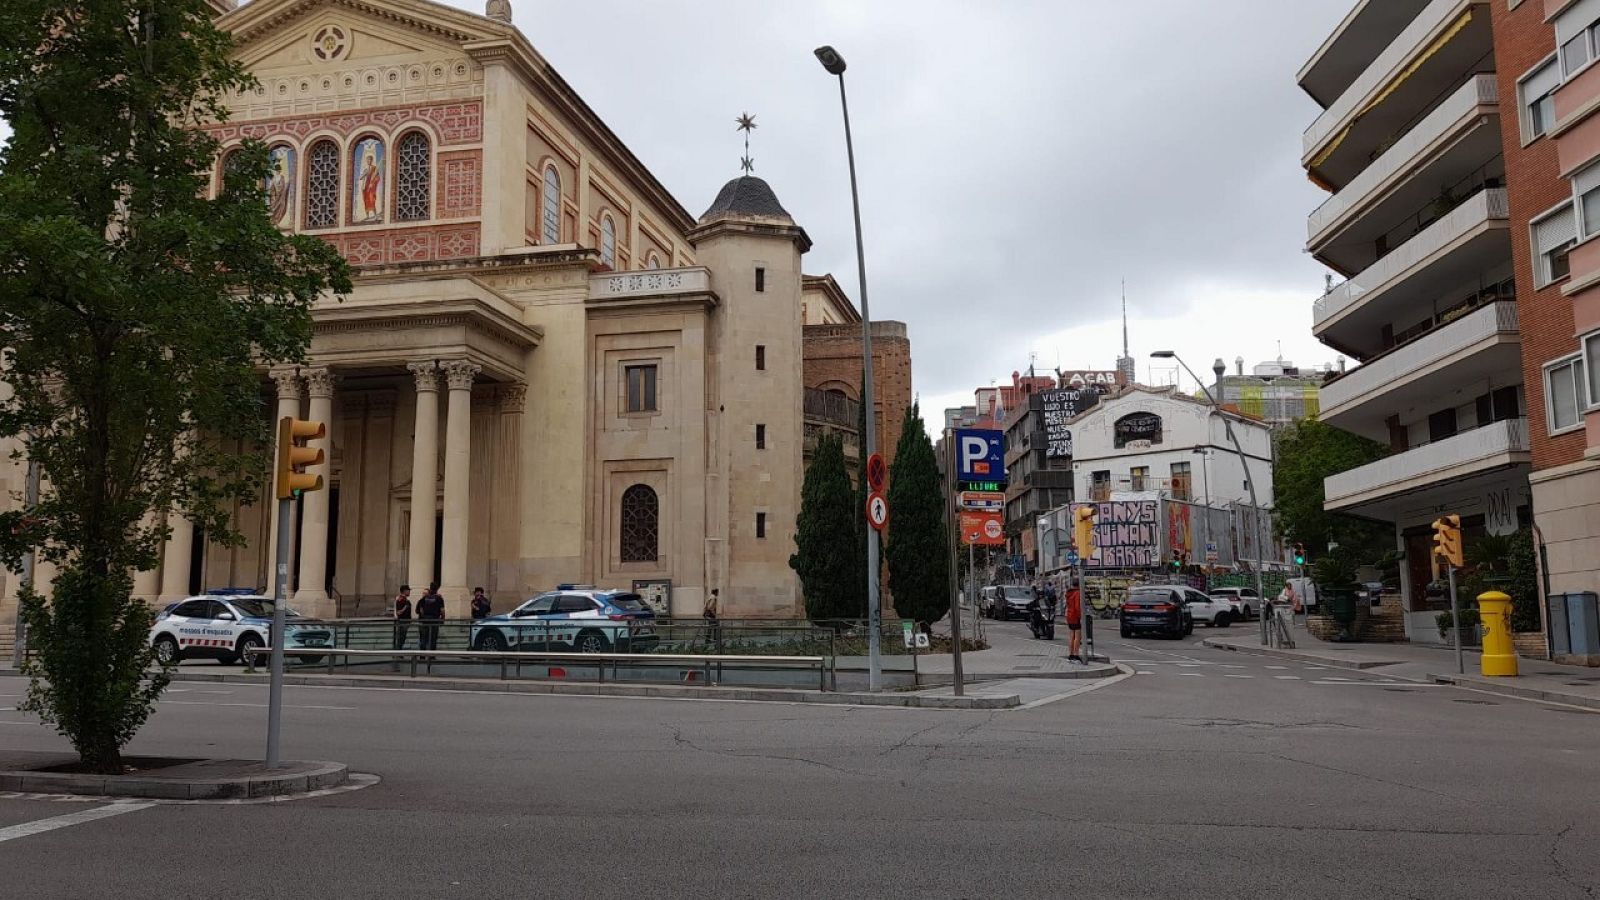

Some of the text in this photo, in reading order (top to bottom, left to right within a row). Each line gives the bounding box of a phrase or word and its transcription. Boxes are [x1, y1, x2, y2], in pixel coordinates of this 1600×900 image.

[1069, 373, 1116, 385] ACAB
[1042, 391, 1080, 402] VUESTRO
[1064, 402, 1075, 410] ES
[962, 436, 989, 473] P
[969, 482, 999, 491] LLIURE
[1099, 502, 1156, 522] ANYS
